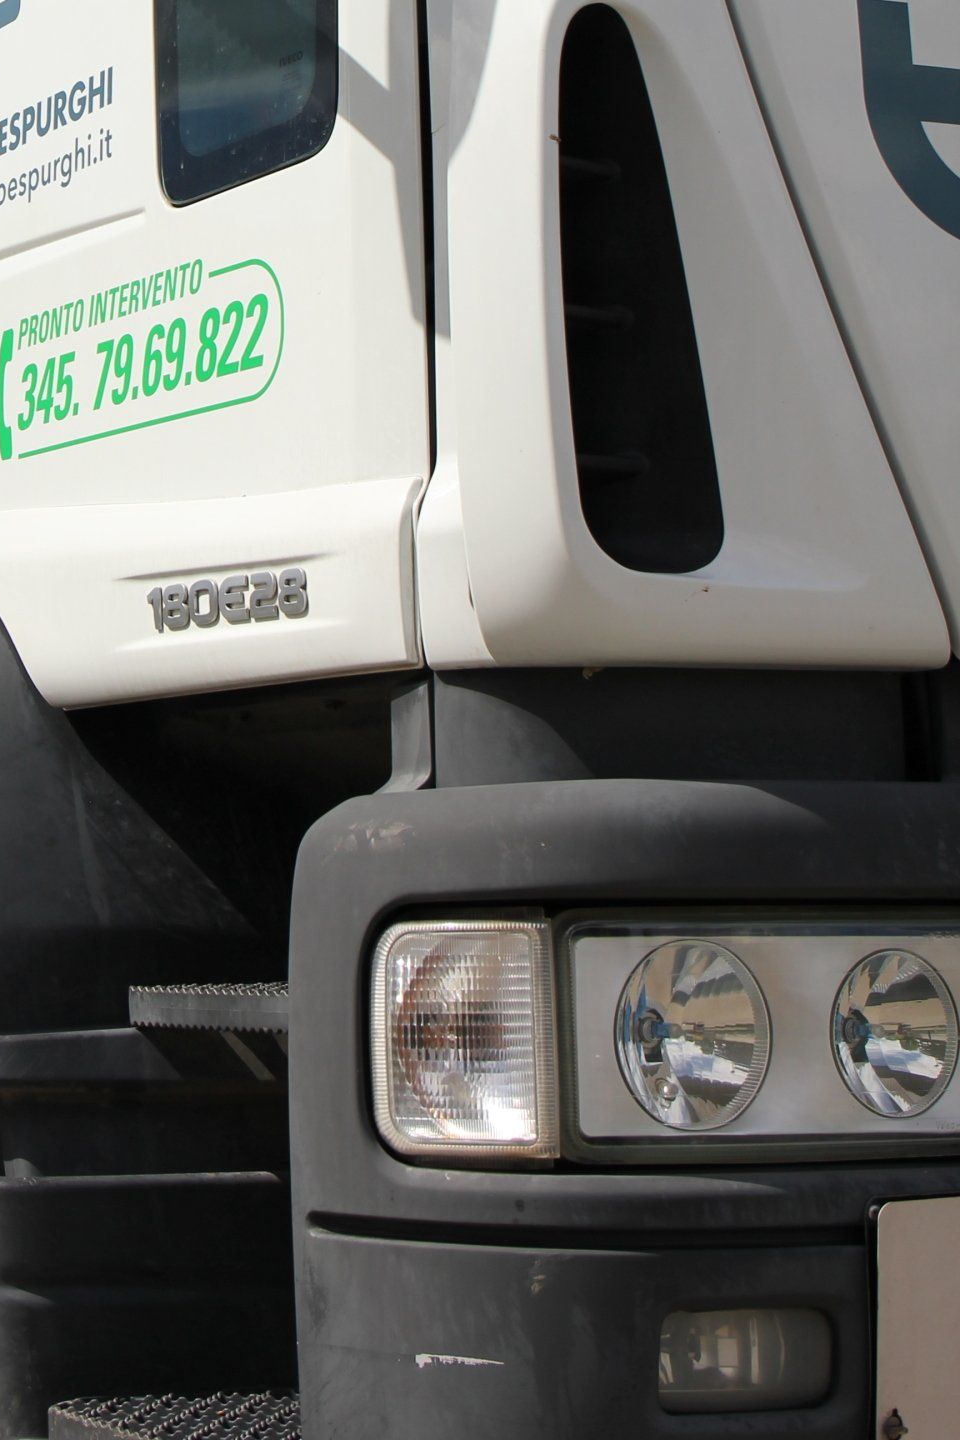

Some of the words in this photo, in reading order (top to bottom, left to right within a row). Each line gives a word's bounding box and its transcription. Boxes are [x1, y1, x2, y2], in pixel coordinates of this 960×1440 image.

[17, 298, 85, 350] PRONTO
[88, 258, 203, 328] INTERVENTO
[17, 350, 80, 432] 345.
[93, 293, 269, 411] 79.69.822
[146, 567, 309, 633] 180E28
